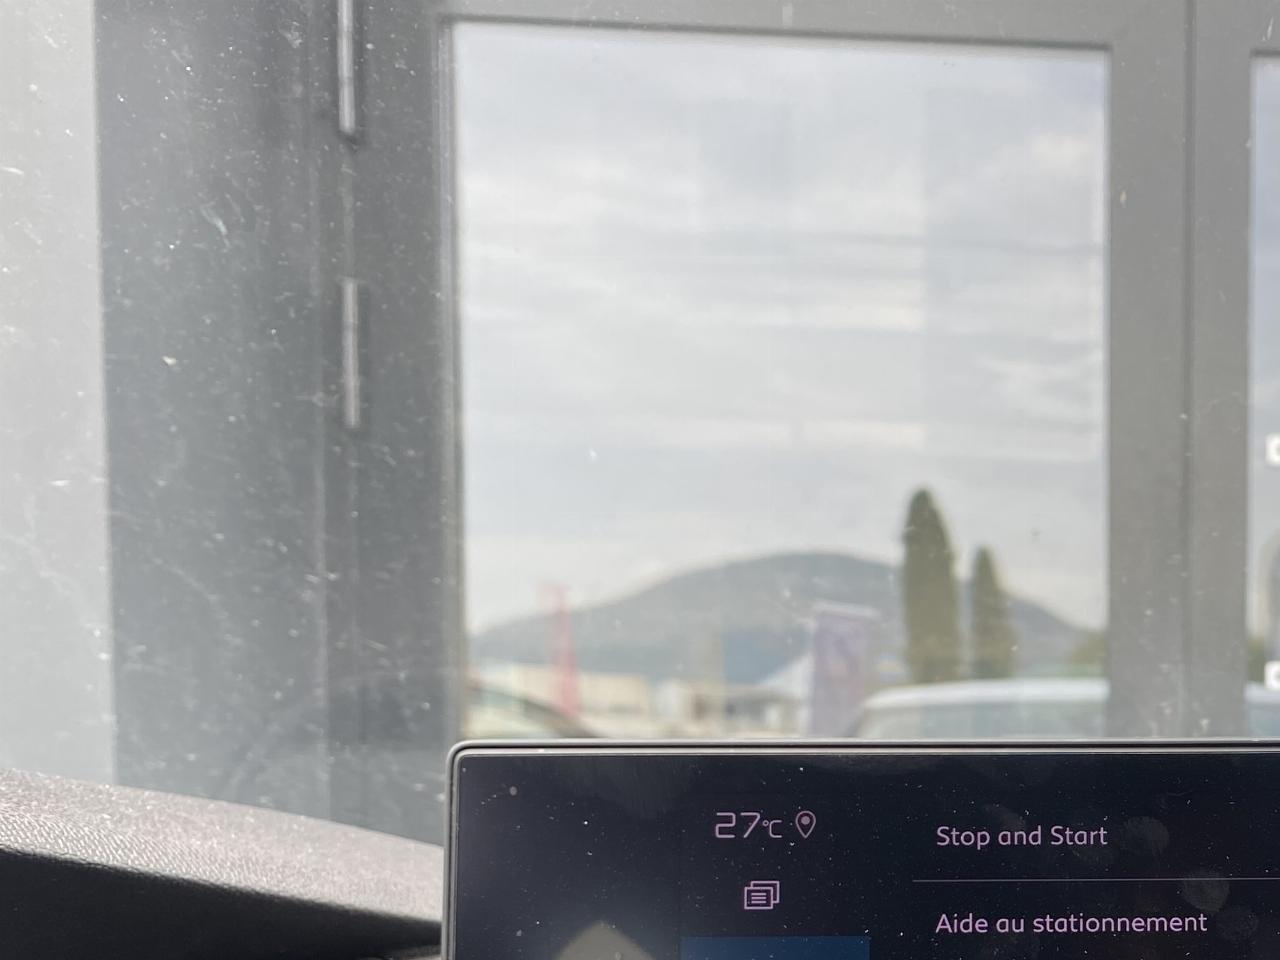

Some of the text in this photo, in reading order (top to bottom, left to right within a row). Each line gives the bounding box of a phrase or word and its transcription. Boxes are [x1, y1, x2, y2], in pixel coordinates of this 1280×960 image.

[936, 825, 1108, 850] Stop and Start
[935, 912, 1208, 934] Aide au stationnement
